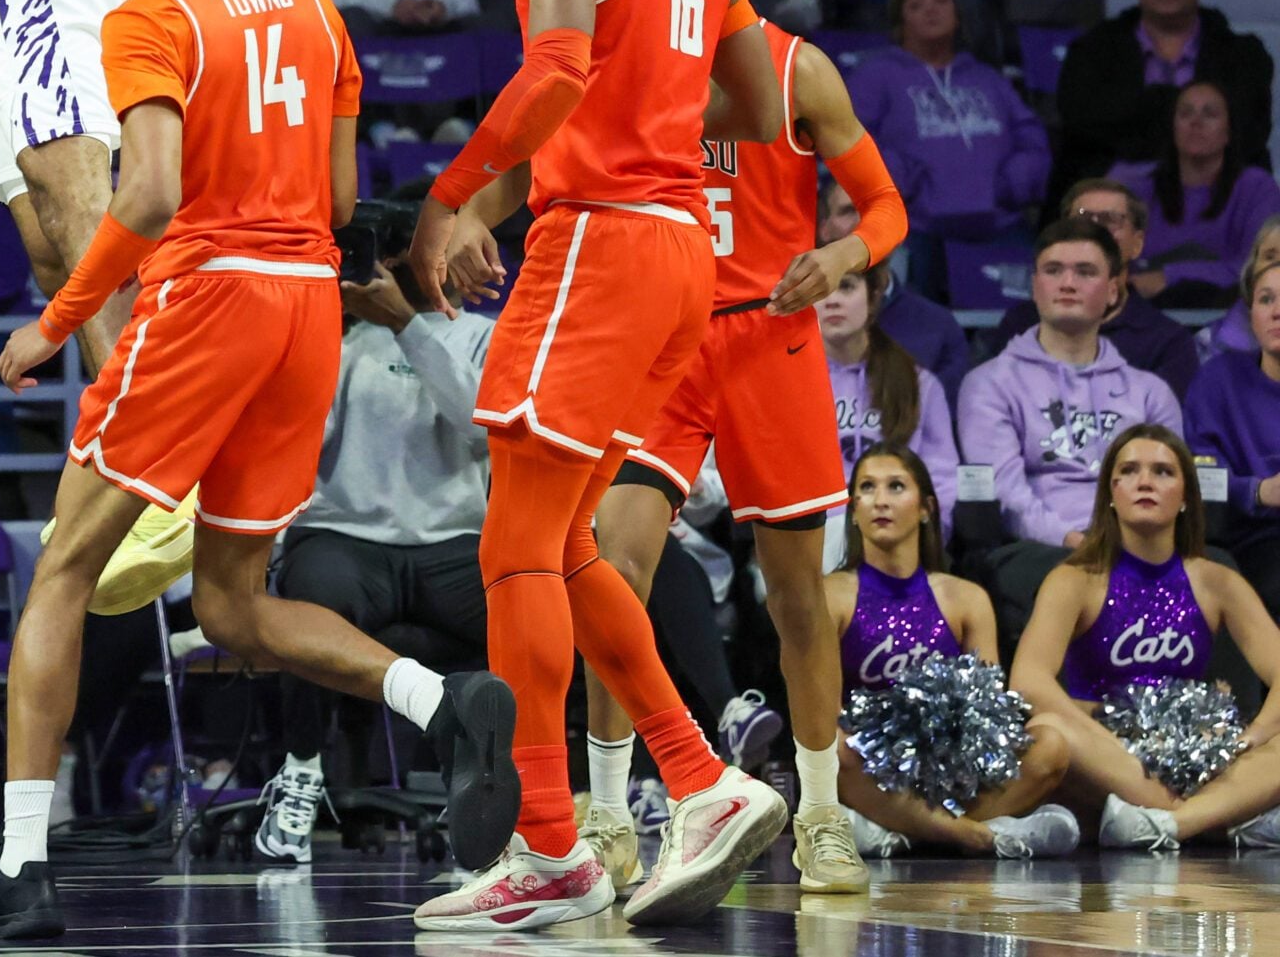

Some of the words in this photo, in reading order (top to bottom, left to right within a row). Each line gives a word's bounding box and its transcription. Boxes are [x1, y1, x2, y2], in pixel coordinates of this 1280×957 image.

[244, 23, 306, 134] 14
[702, 187, 735, 257] 5
[858, 633, 942, 684] Cat
[1110, 617, 1195, 667] Cats
